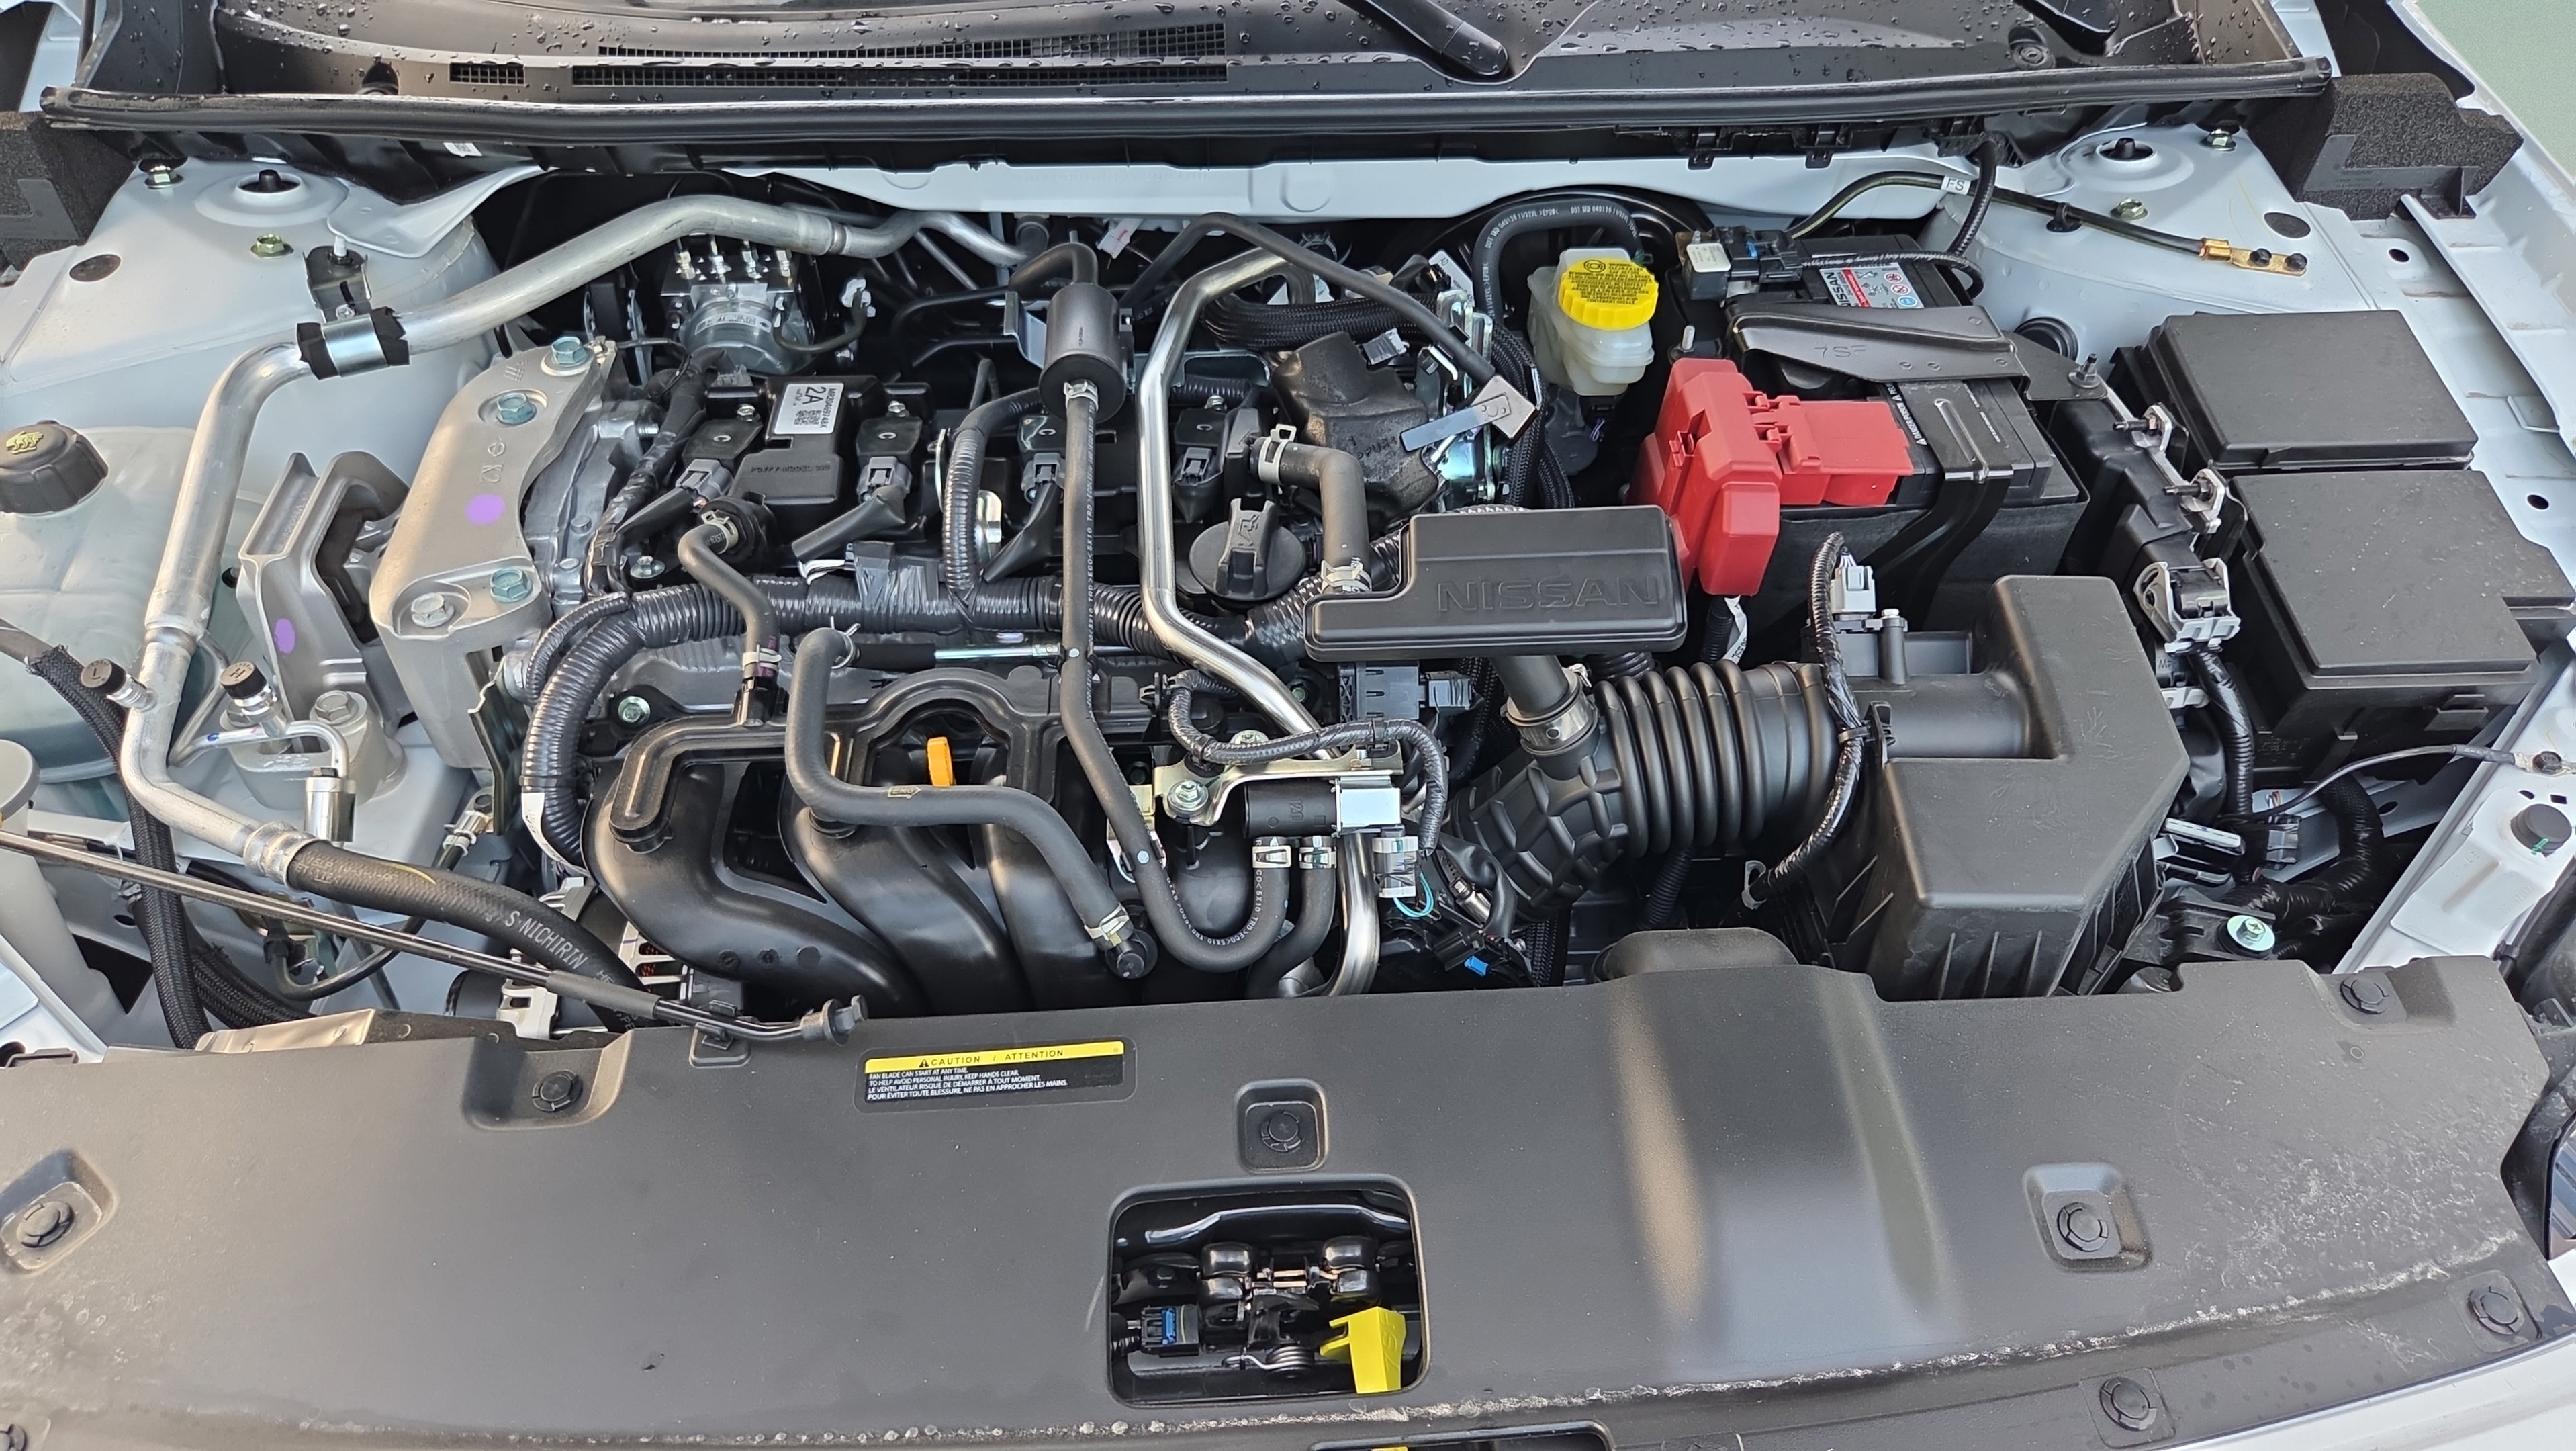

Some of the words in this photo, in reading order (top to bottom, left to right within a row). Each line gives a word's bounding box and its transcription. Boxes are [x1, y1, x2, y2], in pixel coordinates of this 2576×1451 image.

[1946, 178, 1965, 191] FS
[802, 386, 827, 405] 2A
[1438, 577, 1658, 611] NISSAN
[931, 1056, 980, 1066] CAUTION
[1005, 1050, 1064, 1061] ATTENTION
[876, 1084, 918, 1092] VENTILATEUR
[1011, 1075, 1041, 1083] MOMENT.
[913, 1075, 942, 1084] PERSONAL
[996, 1082, 1033, 1091] APPROCHER
